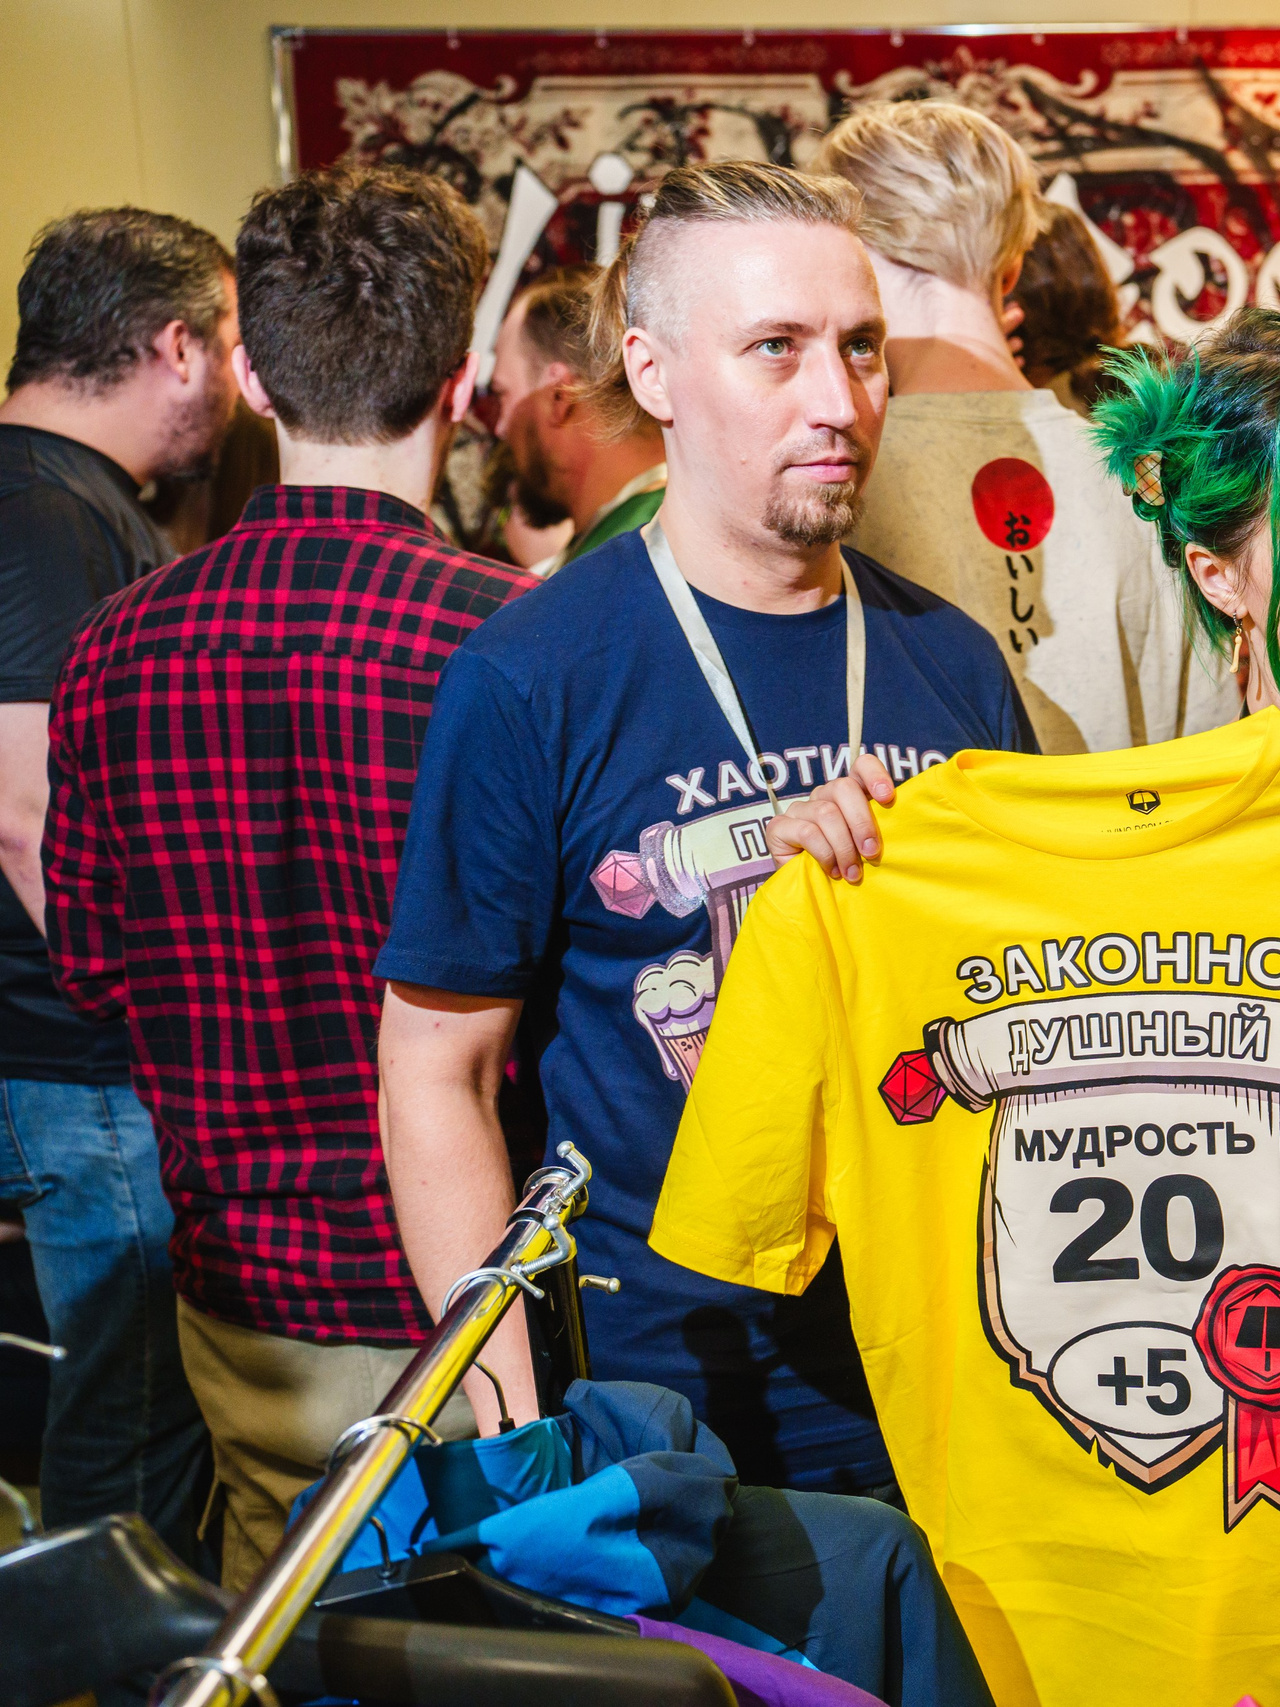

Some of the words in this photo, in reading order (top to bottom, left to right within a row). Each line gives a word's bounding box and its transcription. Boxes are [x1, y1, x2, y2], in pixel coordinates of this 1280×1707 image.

[1004, 511, 1038, 653] おいしい
[1008, 1003, 1271, 1075] ДУШНЫЙ
[1014, 1121, 1256, 1168] МУДРОСТЬ
[1049, 1173, 1225, 1283] 20
[1097, 1347, 1192, 1416] +5
